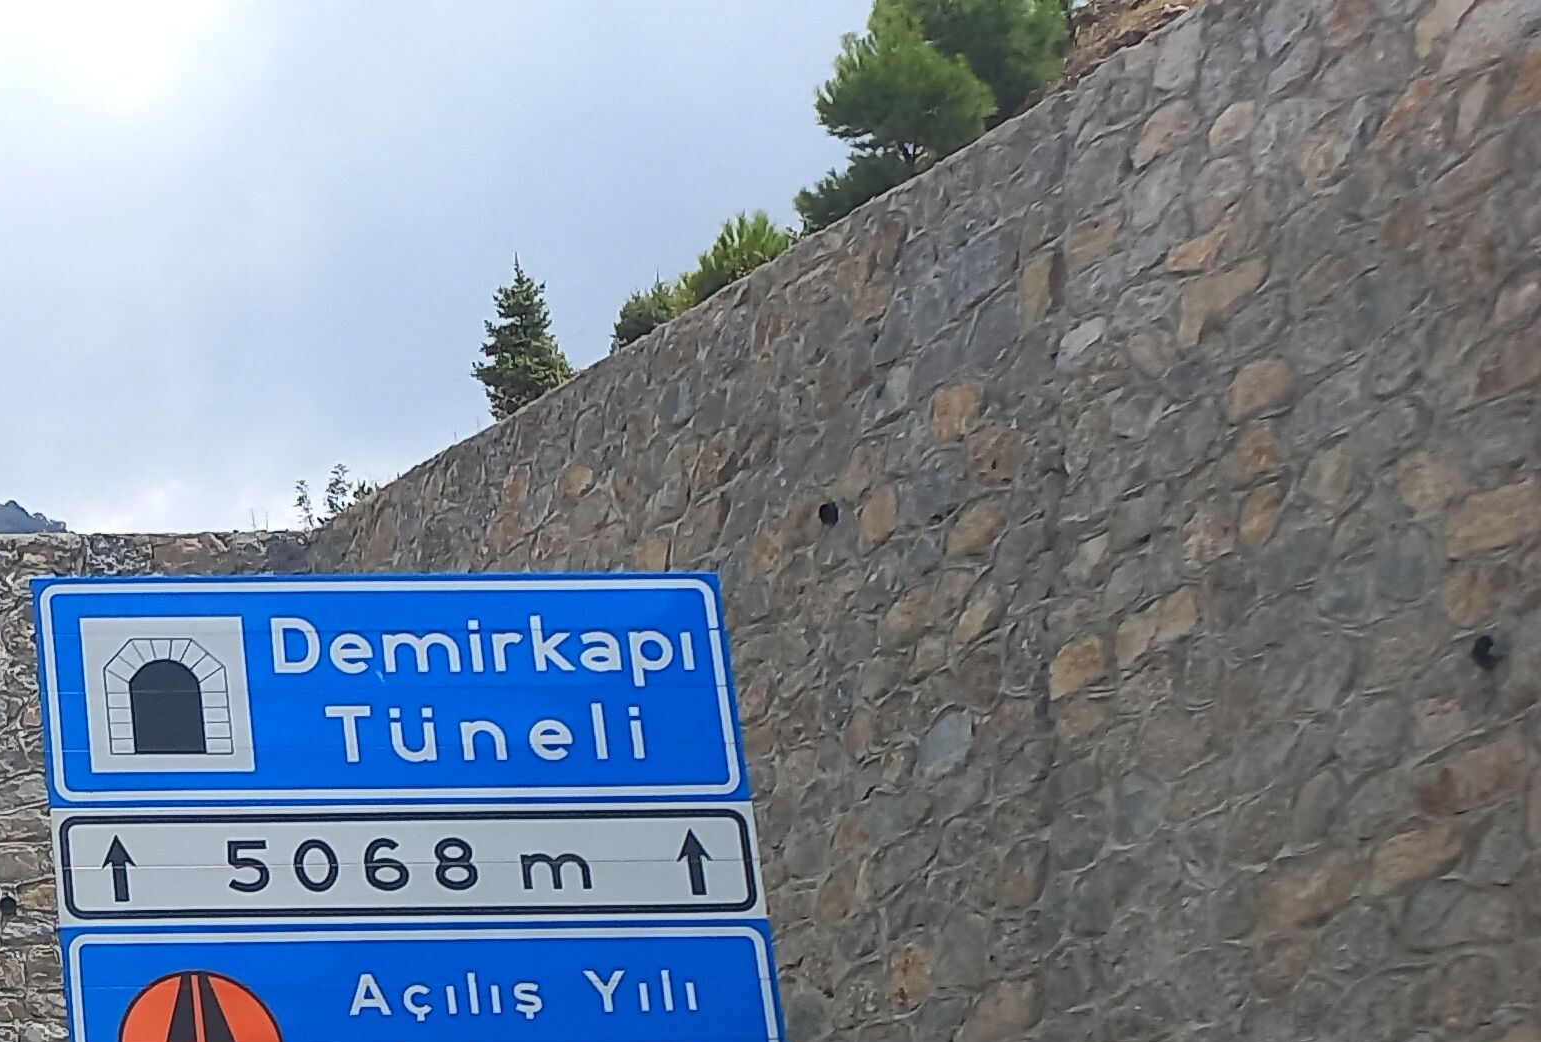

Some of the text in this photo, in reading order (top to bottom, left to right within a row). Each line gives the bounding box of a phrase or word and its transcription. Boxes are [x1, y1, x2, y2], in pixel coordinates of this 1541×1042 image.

[270, 615, 696, 687] Demirkapı
[324, 702, 646, 763] Tüneli
[226, 836, 593, 894] 5068 m
[349, 968, 700, 1023] Açılış Yılı
